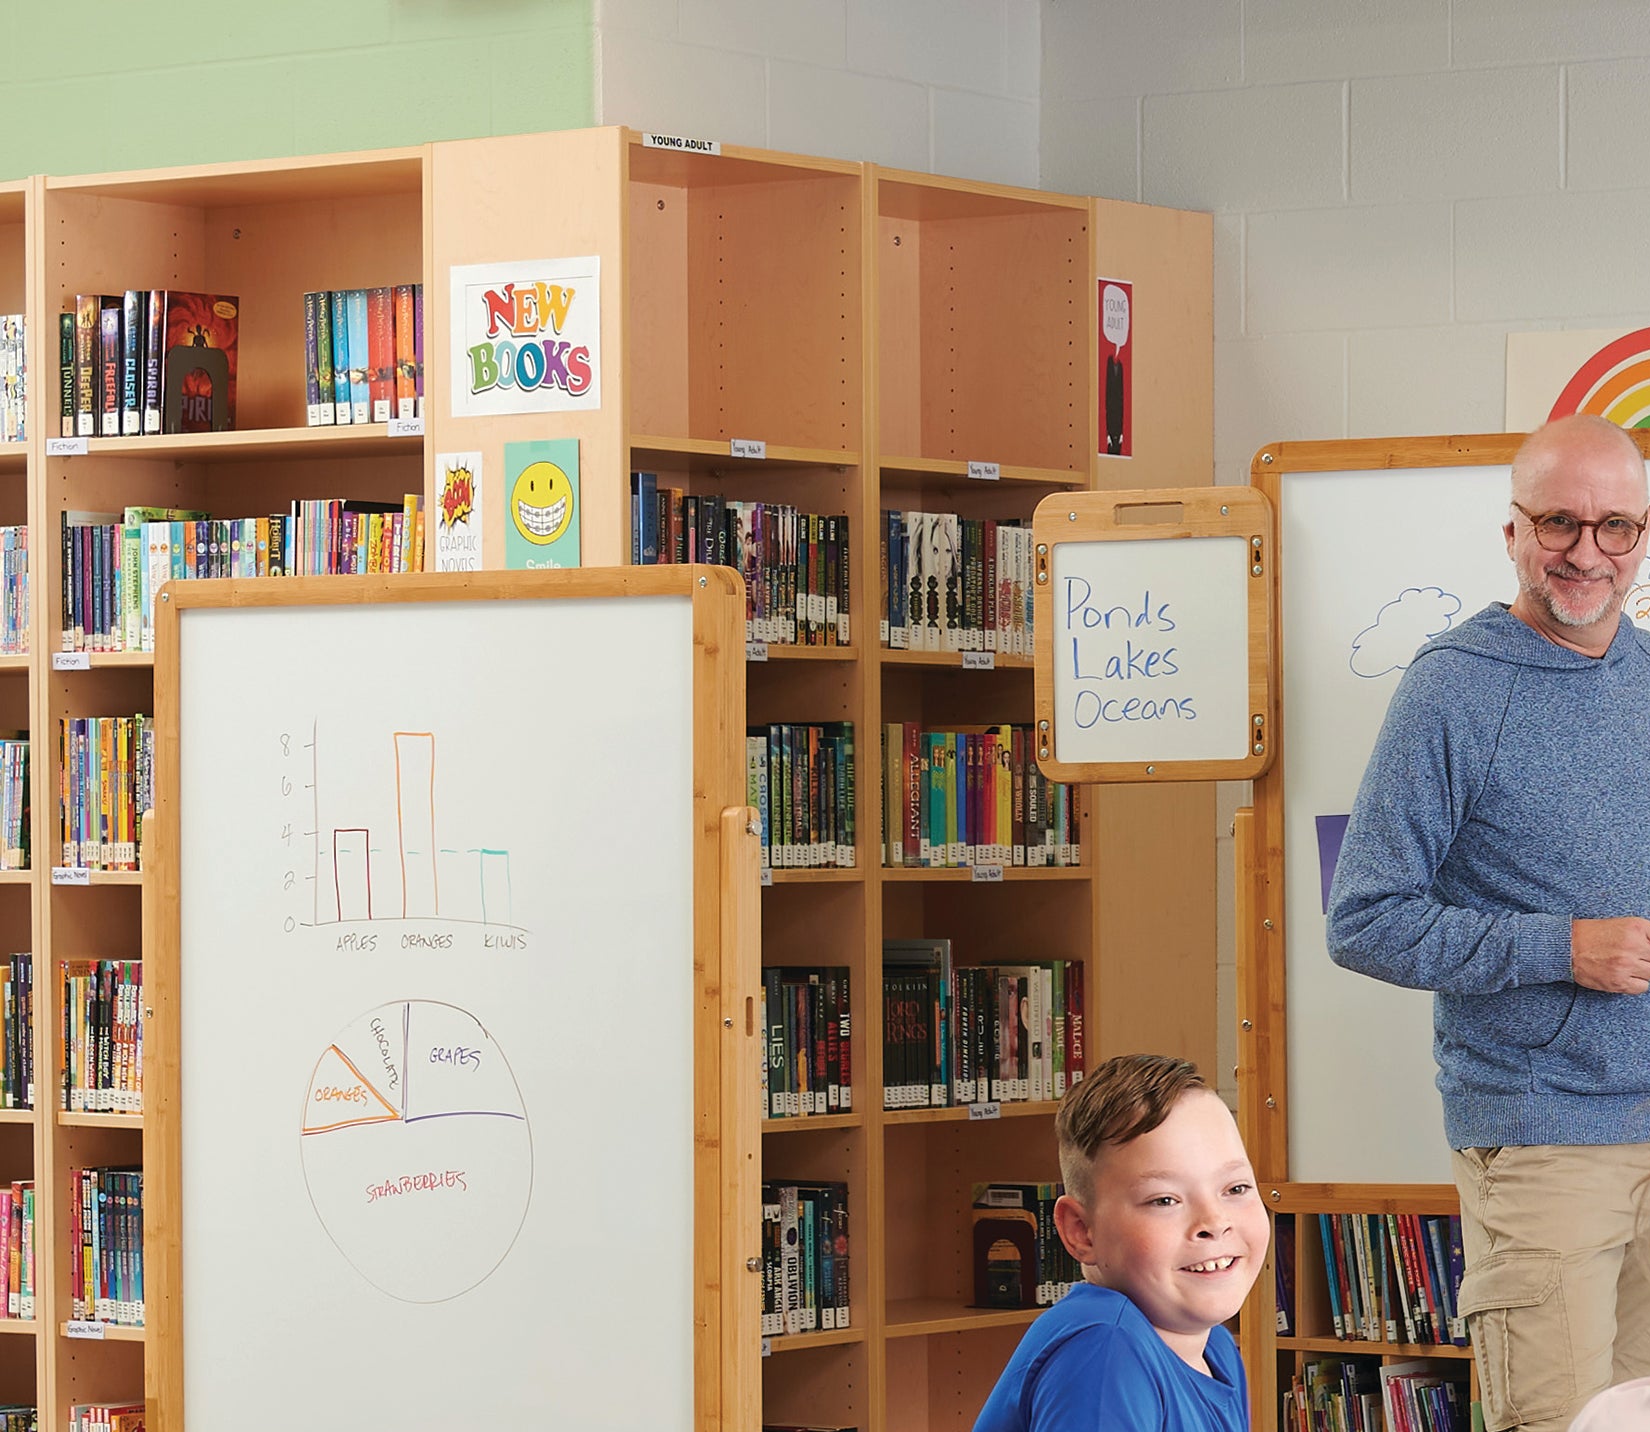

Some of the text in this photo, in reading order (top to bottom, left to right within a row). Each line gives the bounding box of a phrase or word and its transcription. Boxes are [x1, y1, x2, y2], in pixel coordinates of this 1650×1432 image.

[651, 134, 713, 151] YOUNG ADULT
[482, 281, 576, 338] NEW
[1104, 298, 1127, 313] YOUNG
[124, 358, 136, 409] CLOSER
[147, 358, 158, 406] SPIRAL
[467, 339, 592, 397] BOOKS
[80, 367, 93, 413] DEEPER
[397, 422, 421, 433] Fiction
[52, 442, 79, 452] Fiction
[732, 441, 746, 458] Young
[439, 535, 477, 553] GRAPHIC
[132, 547, 140, 610] JOHN STEPHENS
[1064, 576, 1176, 632] Ponds
[56, 657, 81, 666] Fiction
[1073, 636, 1179, 680] Lakes
[1074, 690, 1197, 729] Oceans
[280, 733, 291, 757] 8
[281, 775, 292, 797] 6
[910, 753, 919, 841] ALLEGIANT
[281, 823, 293, 847] 4
[284, 871, 296, 890] 2
[336, 933, 528, 951] APPLES ORANGES KIWIS
[840, 1013, 850, 1037] TWO
[1072, 1014, 1082, 1059] MALICE
[369, 1017, 400, 1090] CHOCOLATE
[771, 1024, 784, 1068] LIES
[828, 1021, 837, 1062] ALLIES
[429, 1047, 482, 1072] GRAPES
[314, 1085, 369, 1106] ORANGES
[365, 1171, 468, 1203] STRAWBERRIES
[788, 1257, 798, 1311] OBLIVION
